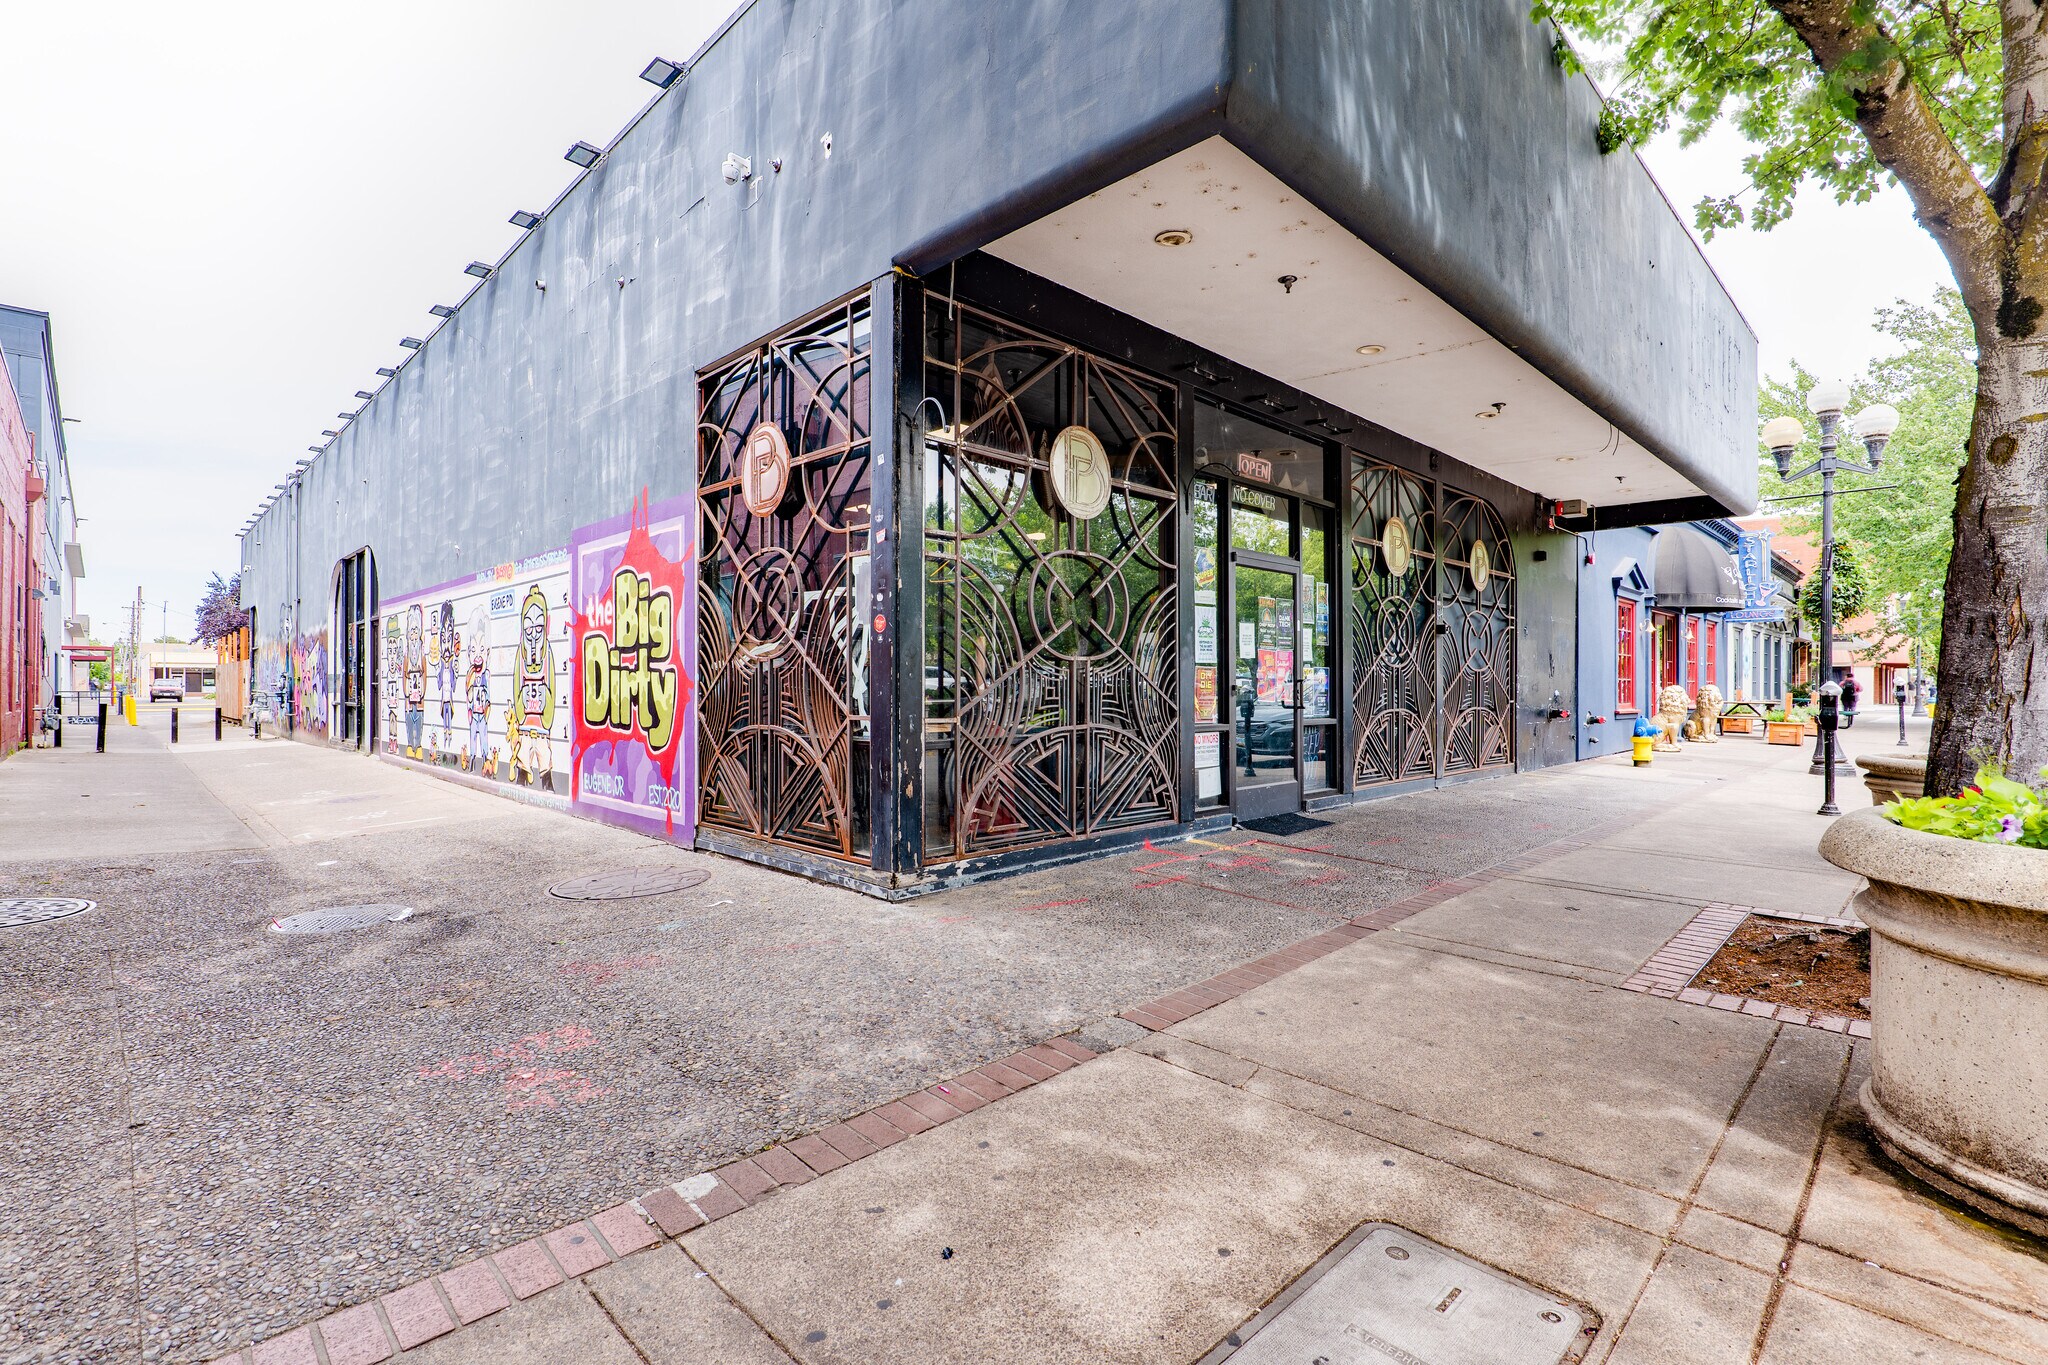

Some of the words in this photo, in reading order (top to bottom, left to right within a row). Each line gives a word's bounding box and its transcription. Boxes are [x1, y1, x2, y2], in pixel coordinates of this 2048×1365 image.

[1241, 459, 1268, 480] OPEN
[1194, 483, 1214, 503] BAR
[1233, 487, 1246, 503] NO
[1248, 491, 1276, 511] COVER
[1743, 536, 1757, 606] STARLIGHT
[1716, 596, 1737, 605] Cocktails
[586, 597, 613, 628] the
[614, 569, 672, 662] Big
[1731, 610, 1774, 619] LOUNGE
[584, 634, 677, 751] Dirty
[1200, 680, 1212, 689] DIE
[1203, 734, 1218, 744] MINORS
